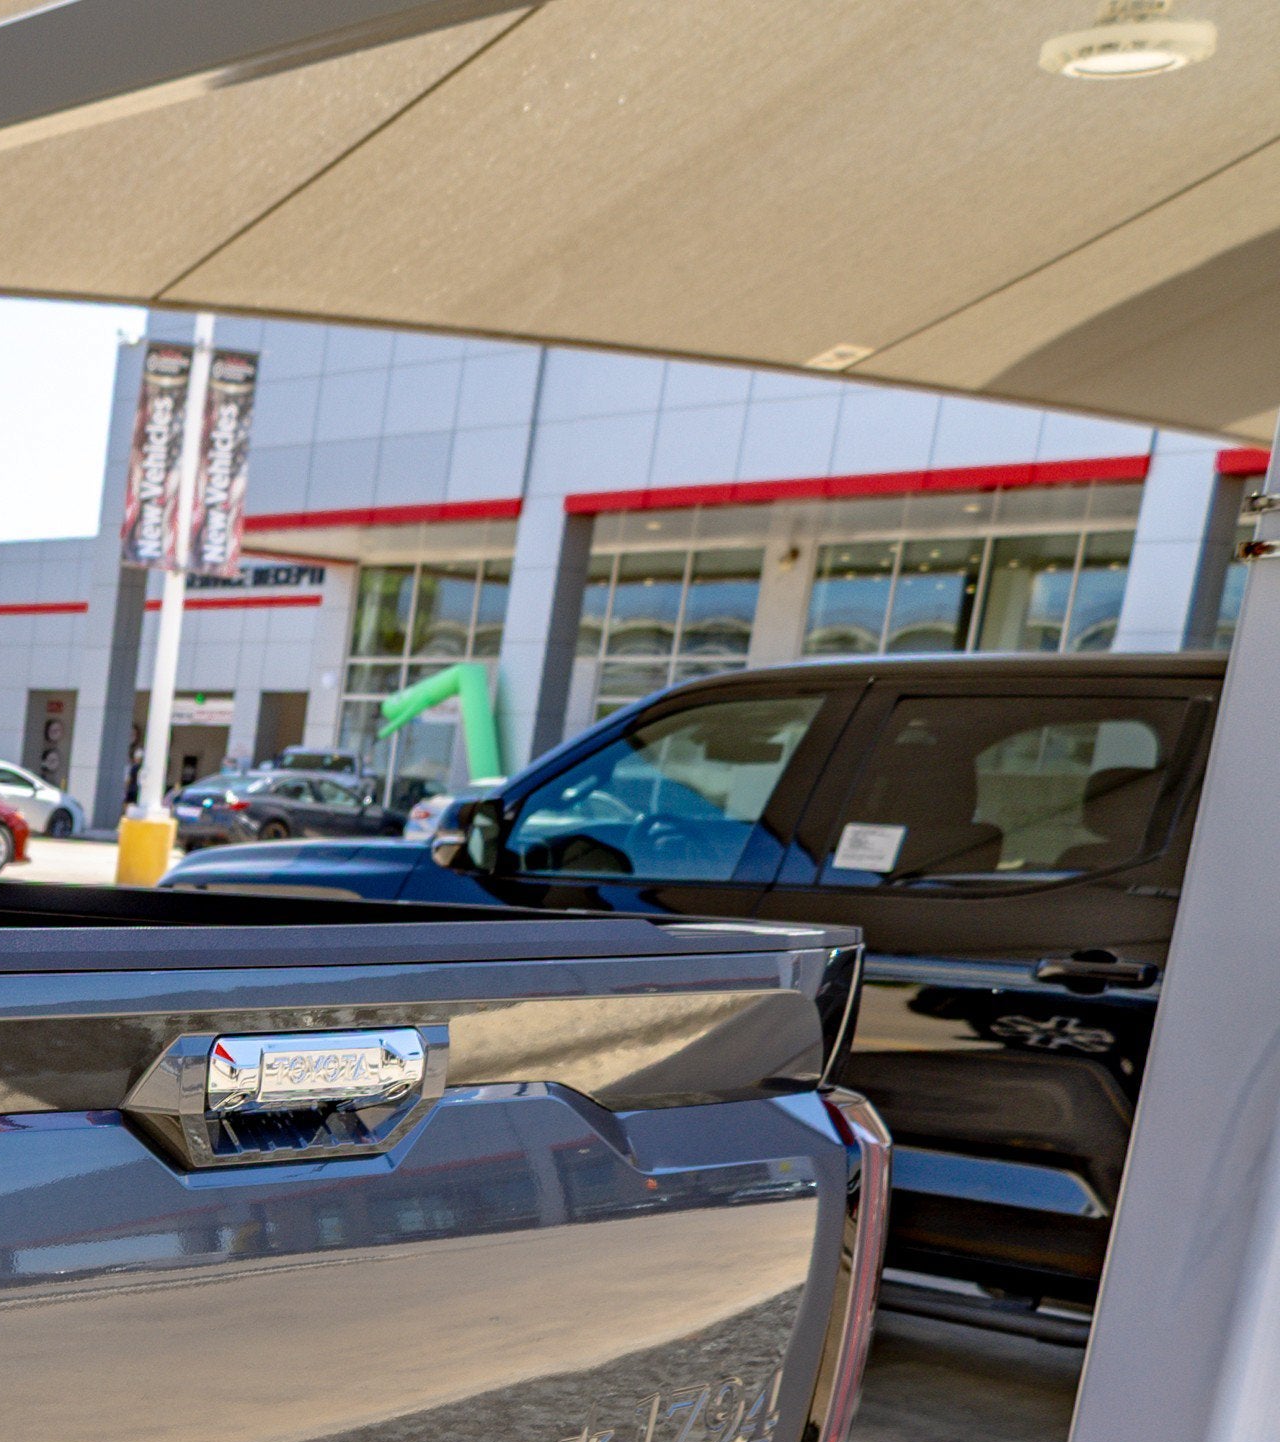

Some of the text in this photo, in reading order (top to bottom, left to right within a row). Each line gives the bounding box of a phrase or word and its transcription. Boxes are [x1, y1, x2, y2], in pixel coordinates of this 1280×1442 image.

[137, 505, 163, 559] New
[202, 509, 228, 564] New
[272, 1052, 371, 1085] TOYOTA
